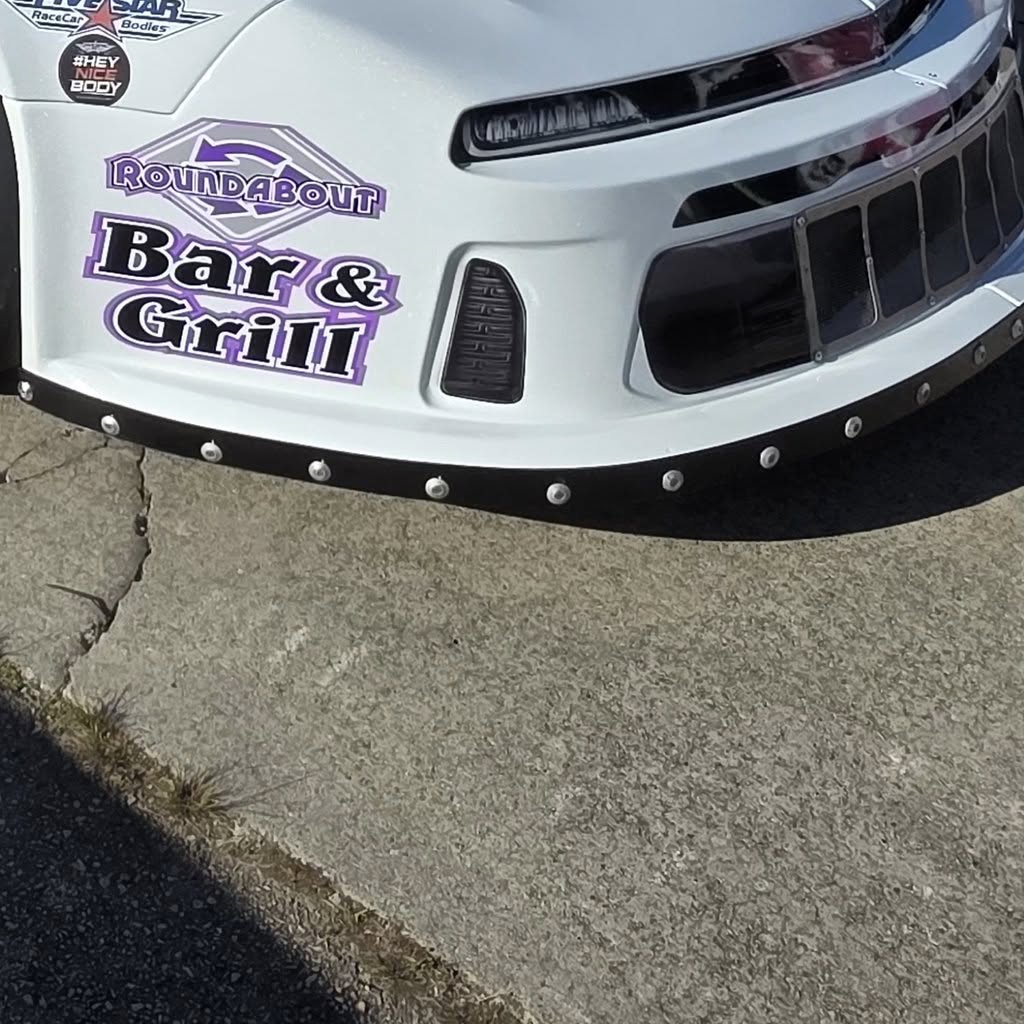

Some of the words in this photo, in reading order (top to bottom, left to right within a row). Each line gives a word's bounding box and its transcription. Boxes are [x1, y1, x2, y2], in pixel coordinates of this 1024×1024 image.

[31, 10, 84, 24] RaceCar
[121, 19, 168, 33] Bodies
[72, 55, 120, 68] #HEY
[76, 68, 118, 80] NICE
[70, 80, 122, 96] BODY
[93, 221, 302, 298] Bar
[319, 264, 393, 309] &
[116, 296, 361, 377] Grill
